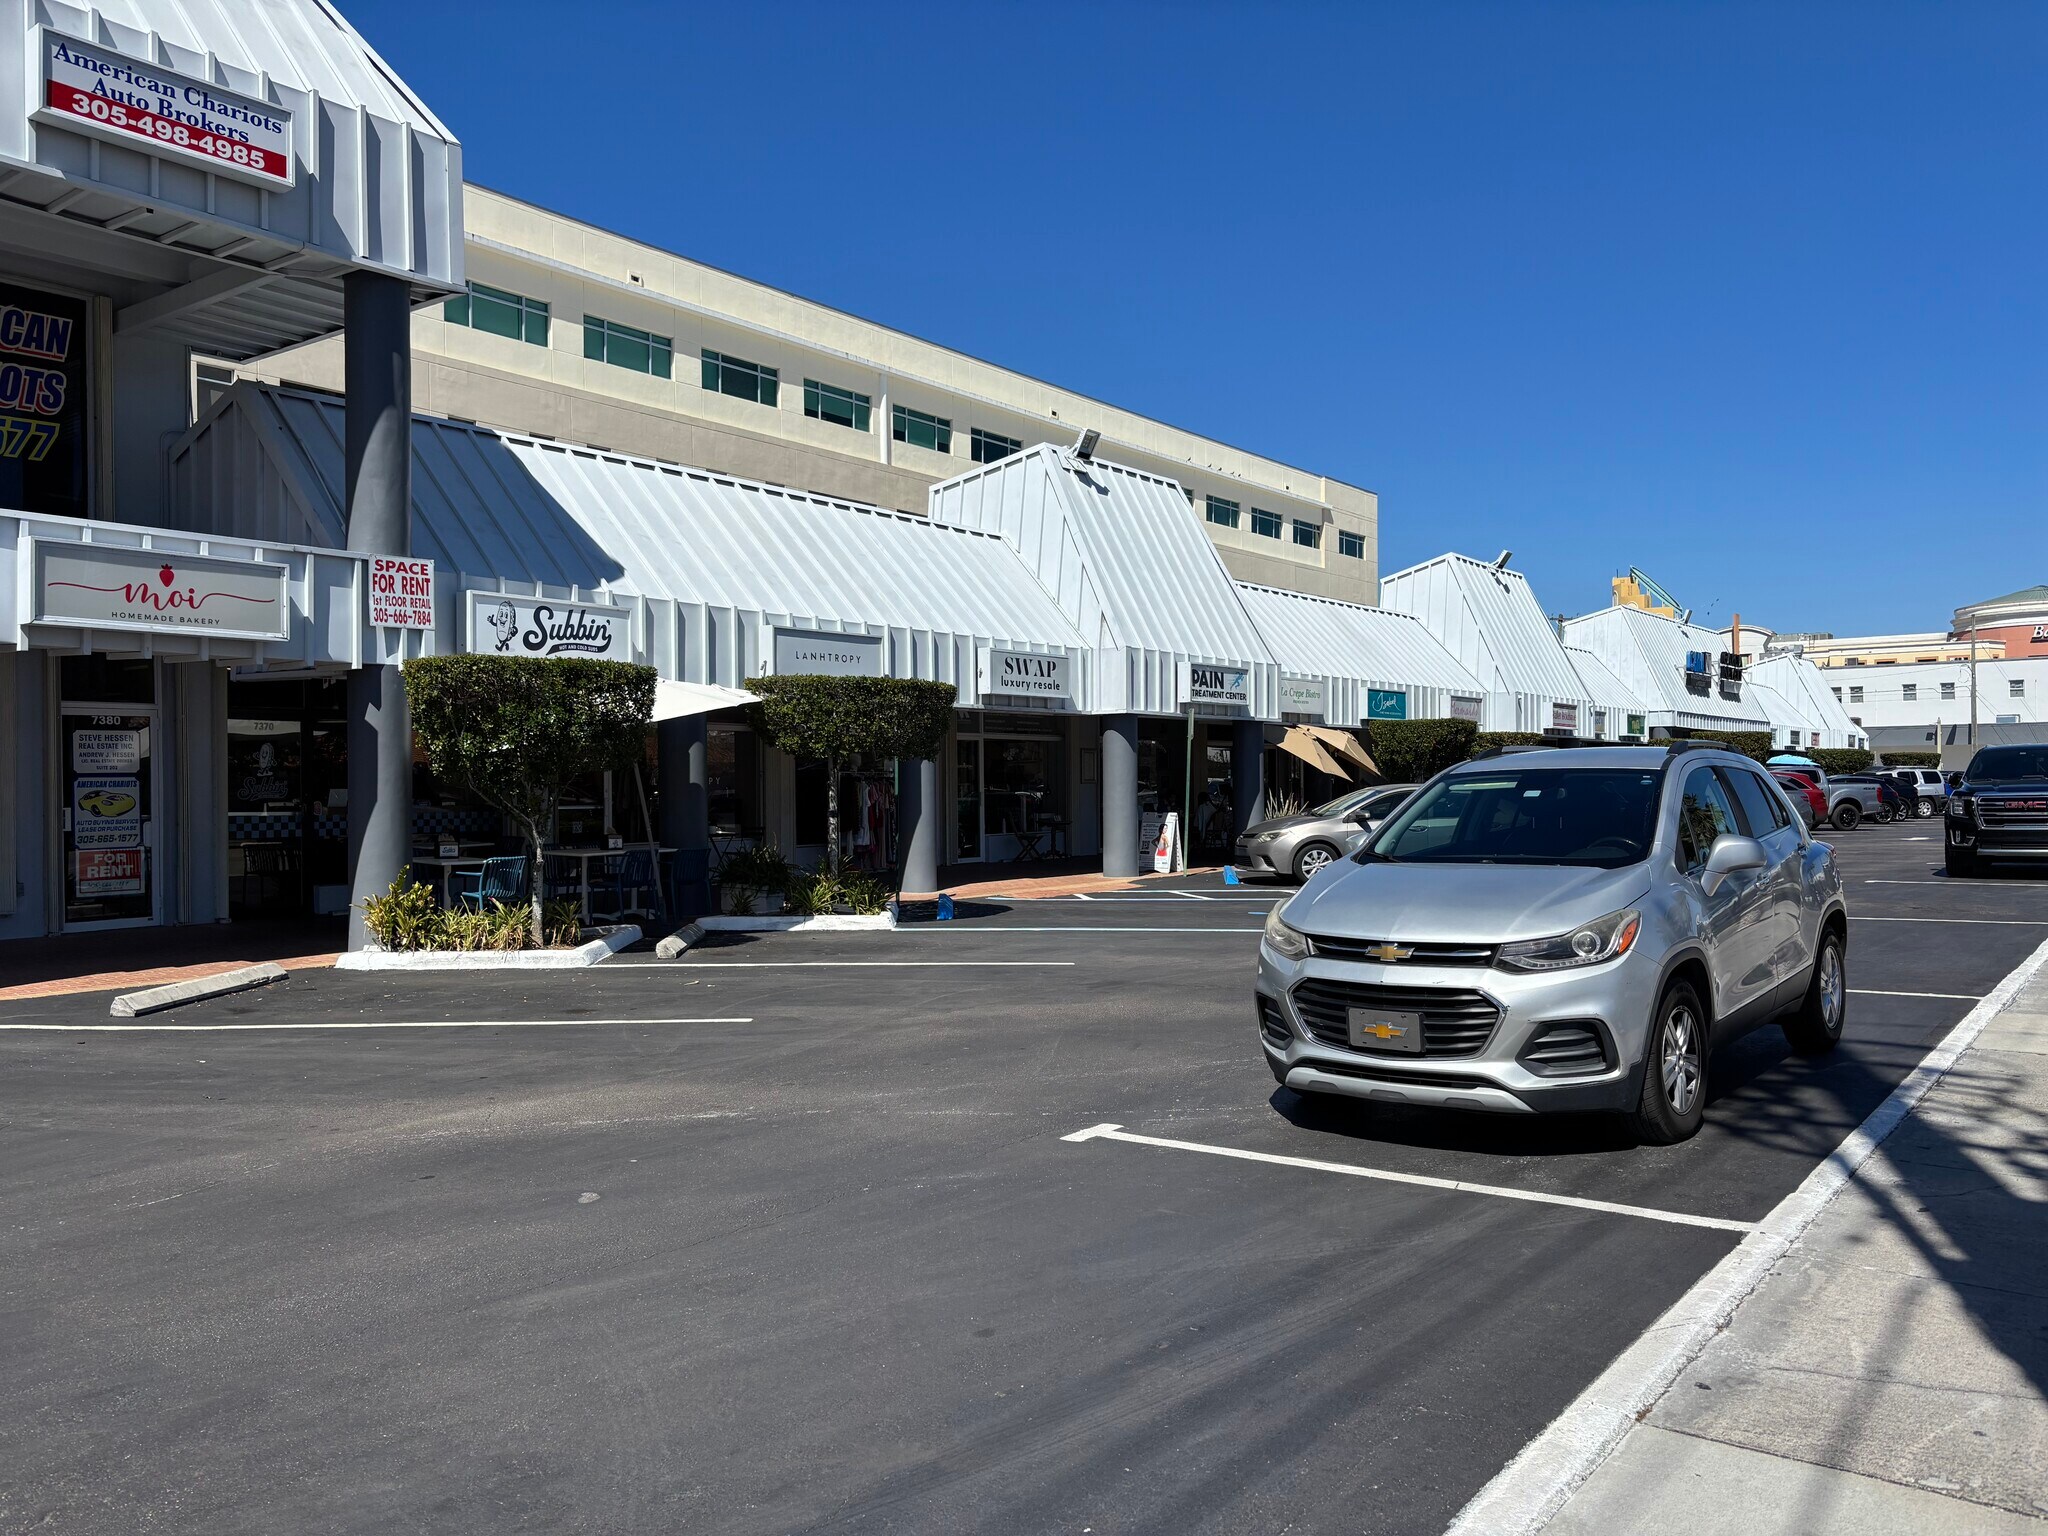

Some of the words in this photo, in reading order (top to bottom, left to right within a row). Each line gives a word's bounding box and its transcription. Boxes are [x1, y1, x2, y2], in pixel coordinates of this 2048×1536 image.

[53, 42, 176, 99] American
[183, 87, 282, 134] Chariots
[91, 77, 150, 111] Auto
[156, 99, 249, 143] Brokers
[72, 93, 266, 170] 305-498-4985
[374, 558, 429, 576] SPACE
[372, 573, 396, 594] FOR
[401, 576, 430, 596] RENT
[372, 594, 382, 606] 1st
[385, 595, 407, 607] FLOOR
[410, 598, 431, 609] RETAIL
[111, 611, 174, 623] HOMEMADE
[179, 616, 221, 625] BAKERY
[373, 607, 431, 625] 305-666-7884
[795, 651, 862, 664] LANHTROPY
[1004, 656, 1057, 678] SWAP
[1001, 675, 1031, 691] luxury
[1033, 679, 1061, 691] resale
[1191, 668, 1224, 690] PAIN
[1191, 689, 1225, 699] TREATMENT
[1225, 692, 1247, 701] CENTER
[91, 715, 121, 726] 7380
[253, 722, 275, 731] 7370
[79, 734, 102, 742] STEVE
[104, 734, 134, 742] HESSEN
[76, 780, 107, 788] AMERICAN
[108, 780, 138, 788] CHARIOTS
[2005, 801, 2047, 810] GMC
[94, 853, 127, 864] FOR
[87, 864, 134, 878] RENT
